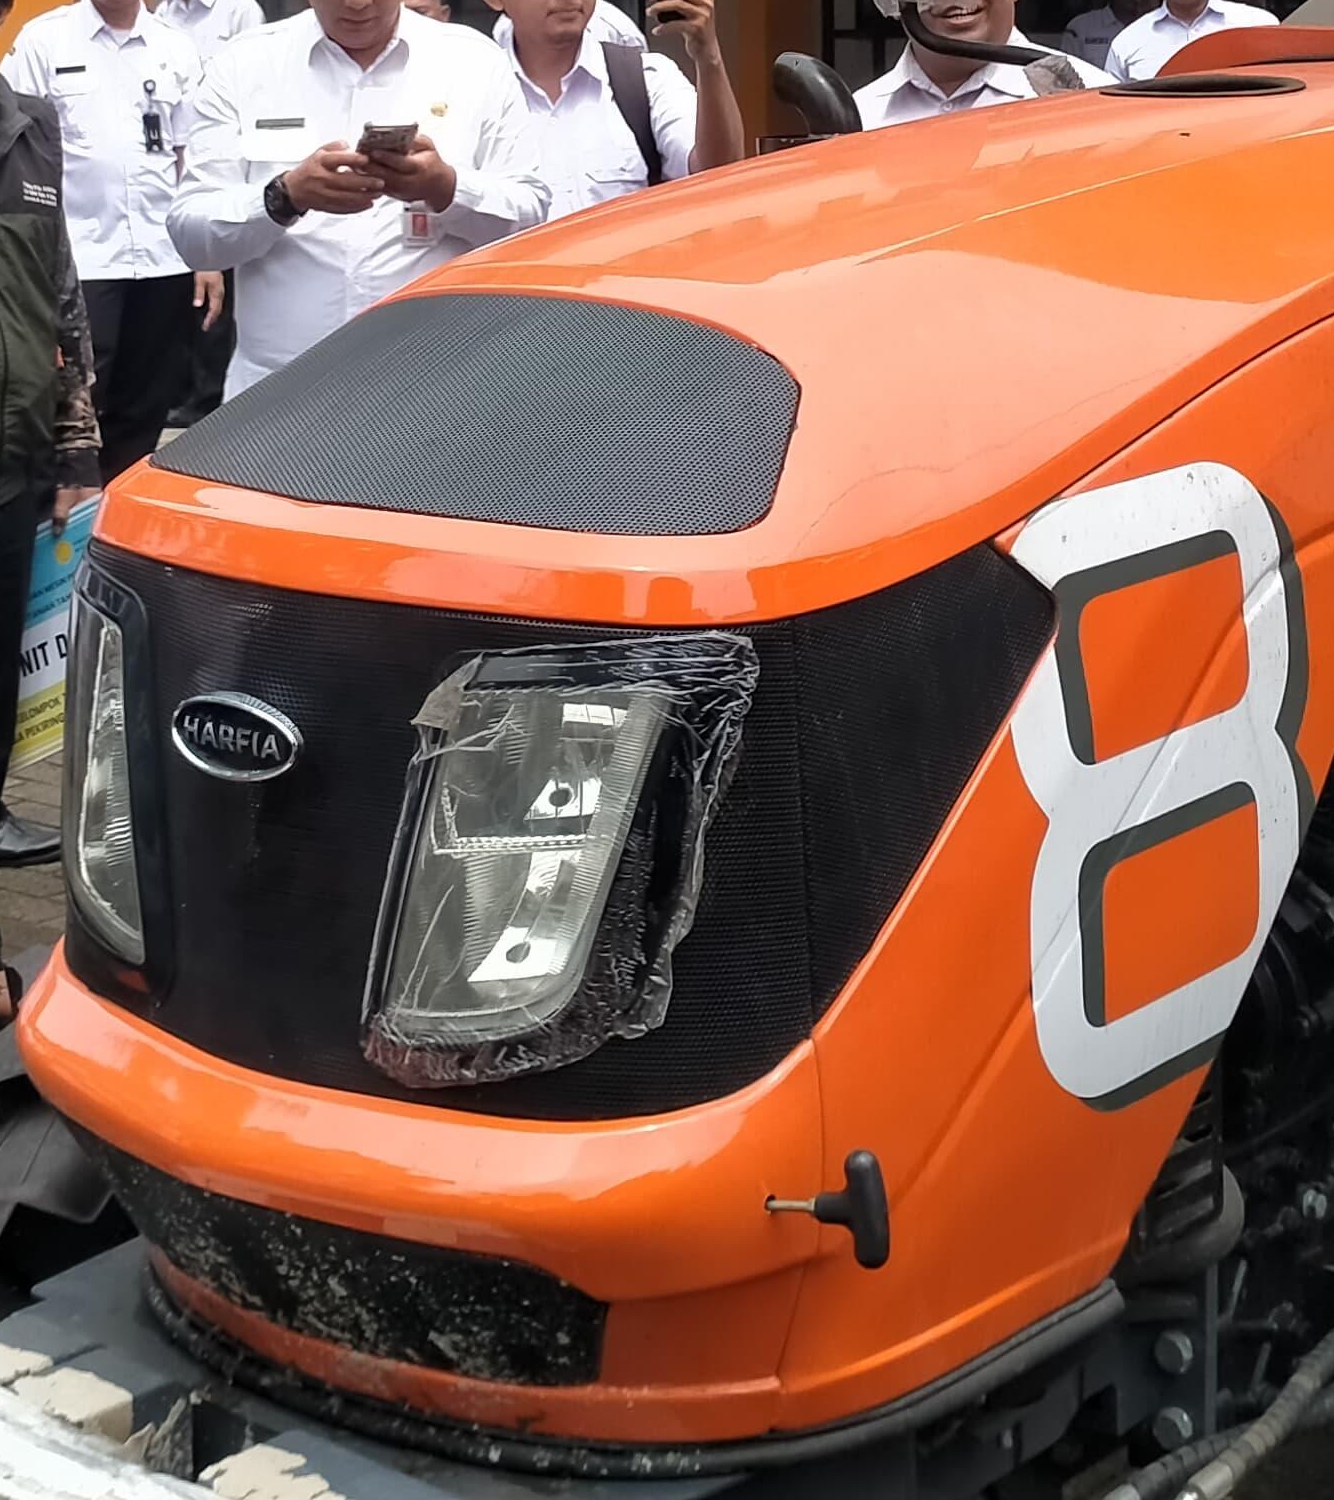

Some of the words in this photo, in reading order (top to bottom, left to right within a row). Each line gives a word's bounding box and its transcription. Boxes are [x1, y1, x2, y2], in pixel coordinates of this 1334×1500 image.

[19, 641, 49, 677] NIT
[55, 633, 68, 659] D
[183, 715, 281, 761] HARFIA
[1009, 461, 1313, 1113] 8
